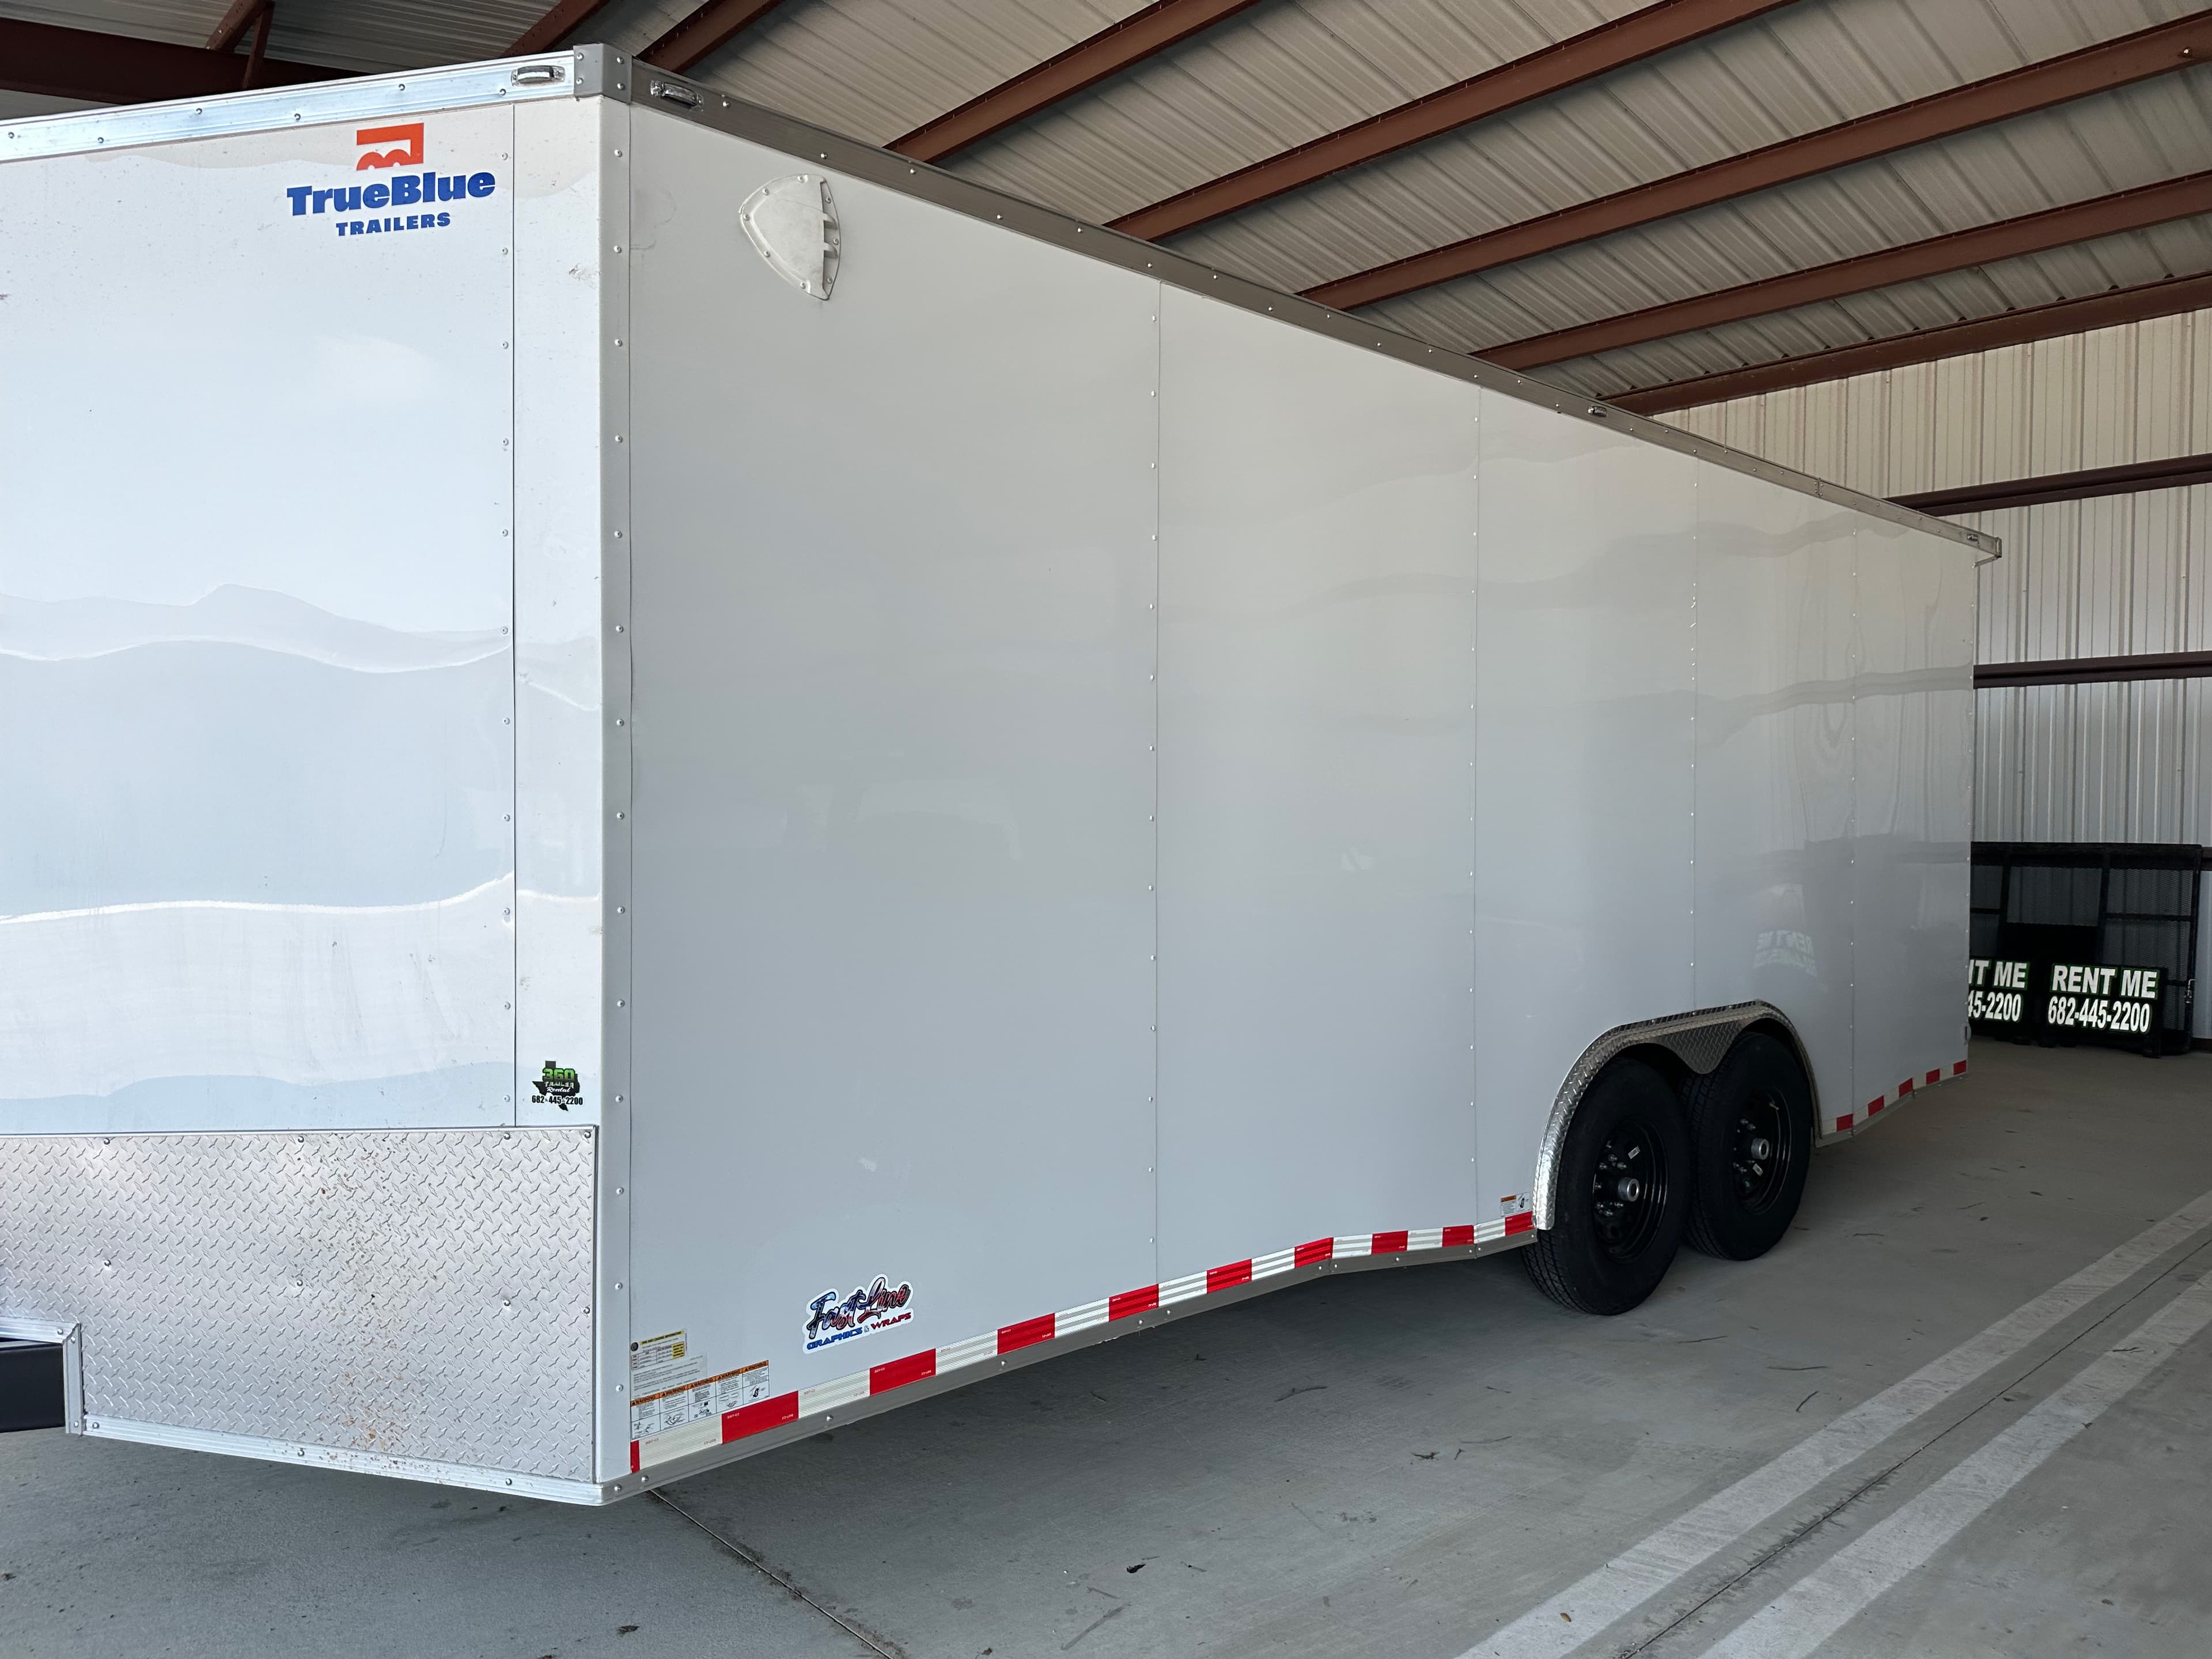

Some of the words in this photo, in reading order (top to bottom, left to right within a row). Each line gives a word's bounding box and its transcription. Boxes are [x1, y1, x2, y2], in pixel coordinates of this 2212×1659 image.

[287, 172, 496, 216] TrueBlue
[336, 212, 450, 236] TRAILERS
[1994, 961, 2027, 988] ME
[2052, 965, 2116, 995] RENT
[2121, 969, 2158, 999] ME
[2048, 996, 2150, 1033] 682-445-2200
[543, 1068, 575, 1081] 360
[806, 1327, 862, 1350] GRAPHICS
[870, 1312, 912, 1330] WRAPS
